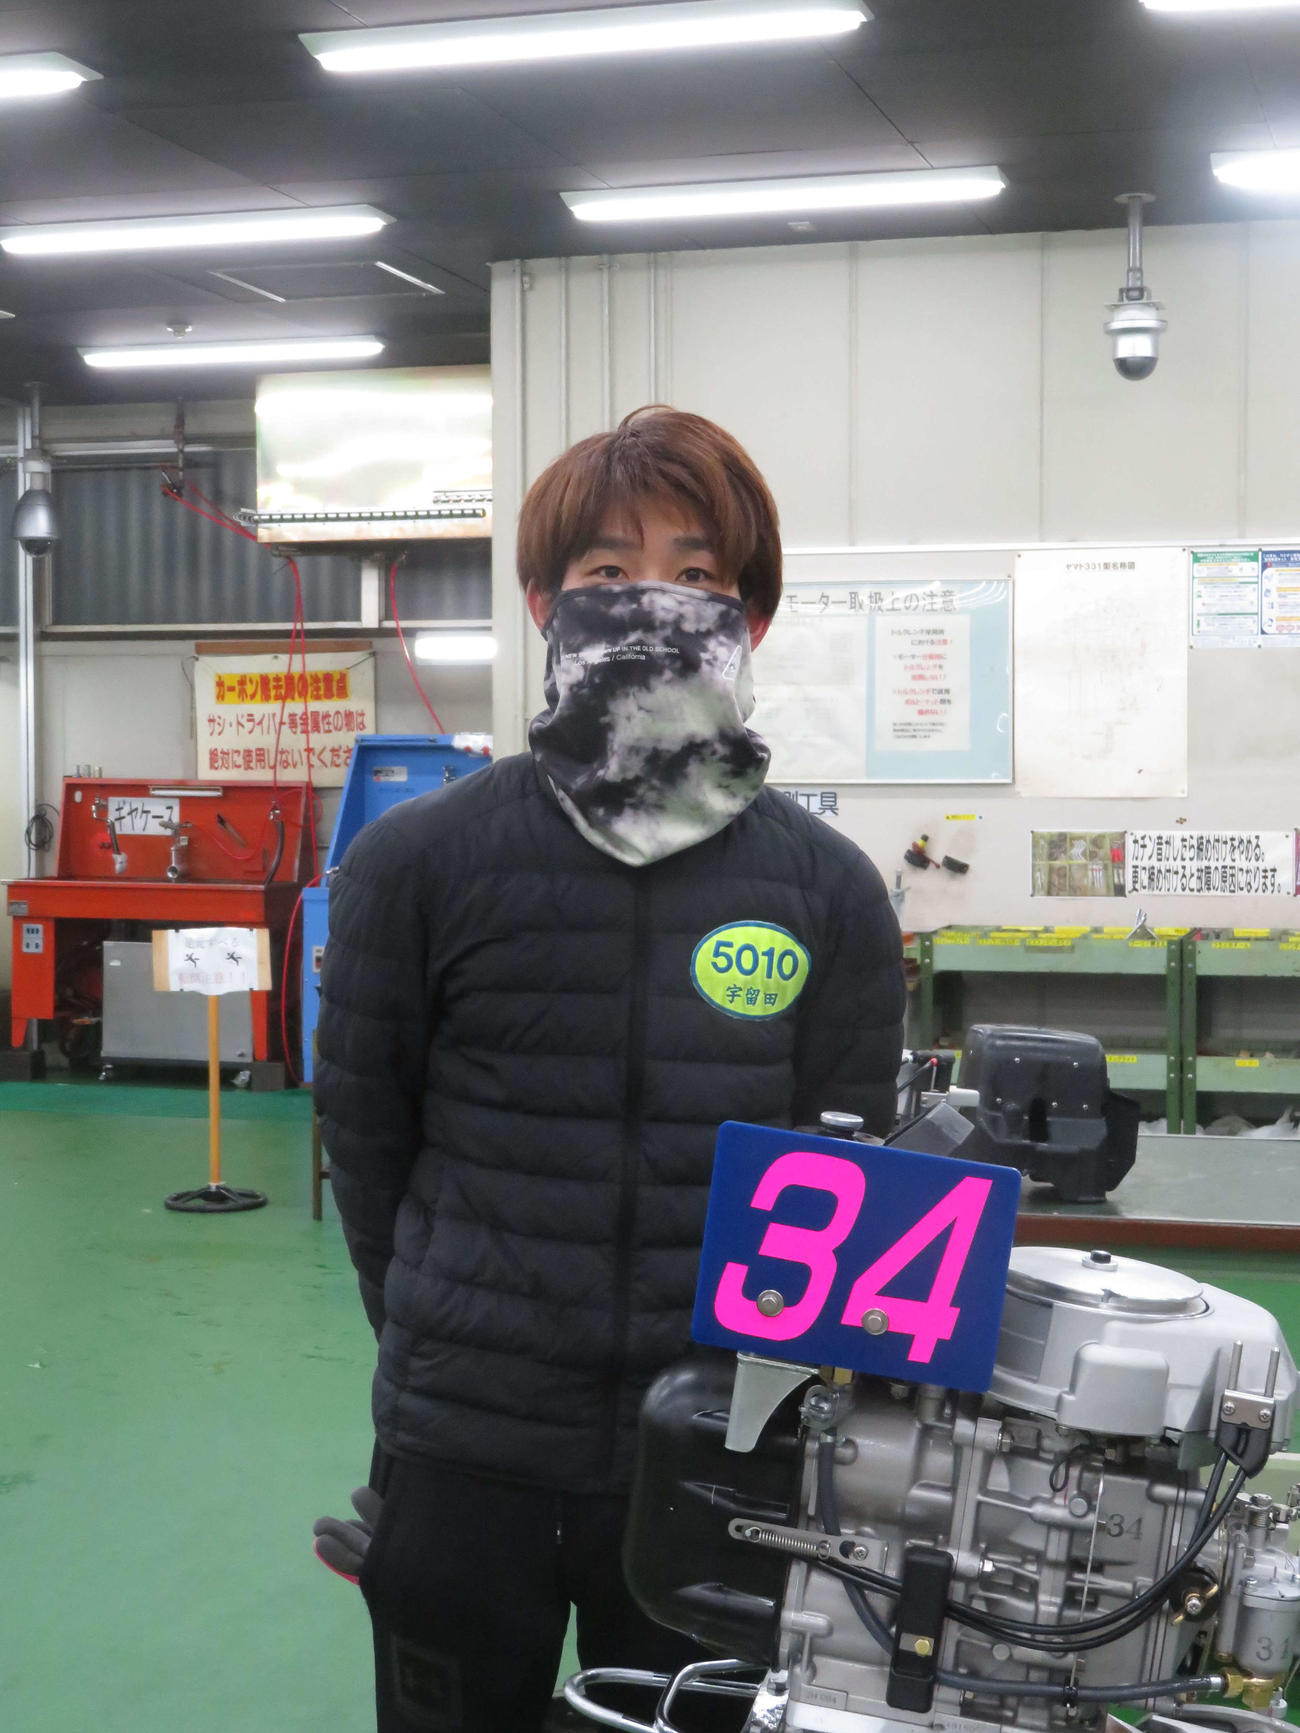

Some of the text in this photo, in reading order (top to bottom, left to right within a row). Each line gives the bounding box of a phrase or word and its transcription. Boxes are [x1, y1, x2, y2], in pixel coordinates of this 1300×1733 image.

[785, 589, 957, 613] モーター取扱上の注意
[616, 653, 646, 661] California
[1131, 834, 1266, 863] カチン音がしたら締め付けをやめる。
[1131, 864, 1282, 894] 更に締め付けると故障の原因になります。
[711, 940, 799, 981] 5010
[726, 984, 779, 1007] 宇留田
[714, 1152, 993, 1364] 34
[1107, 1513, 1144, 1540] 34
